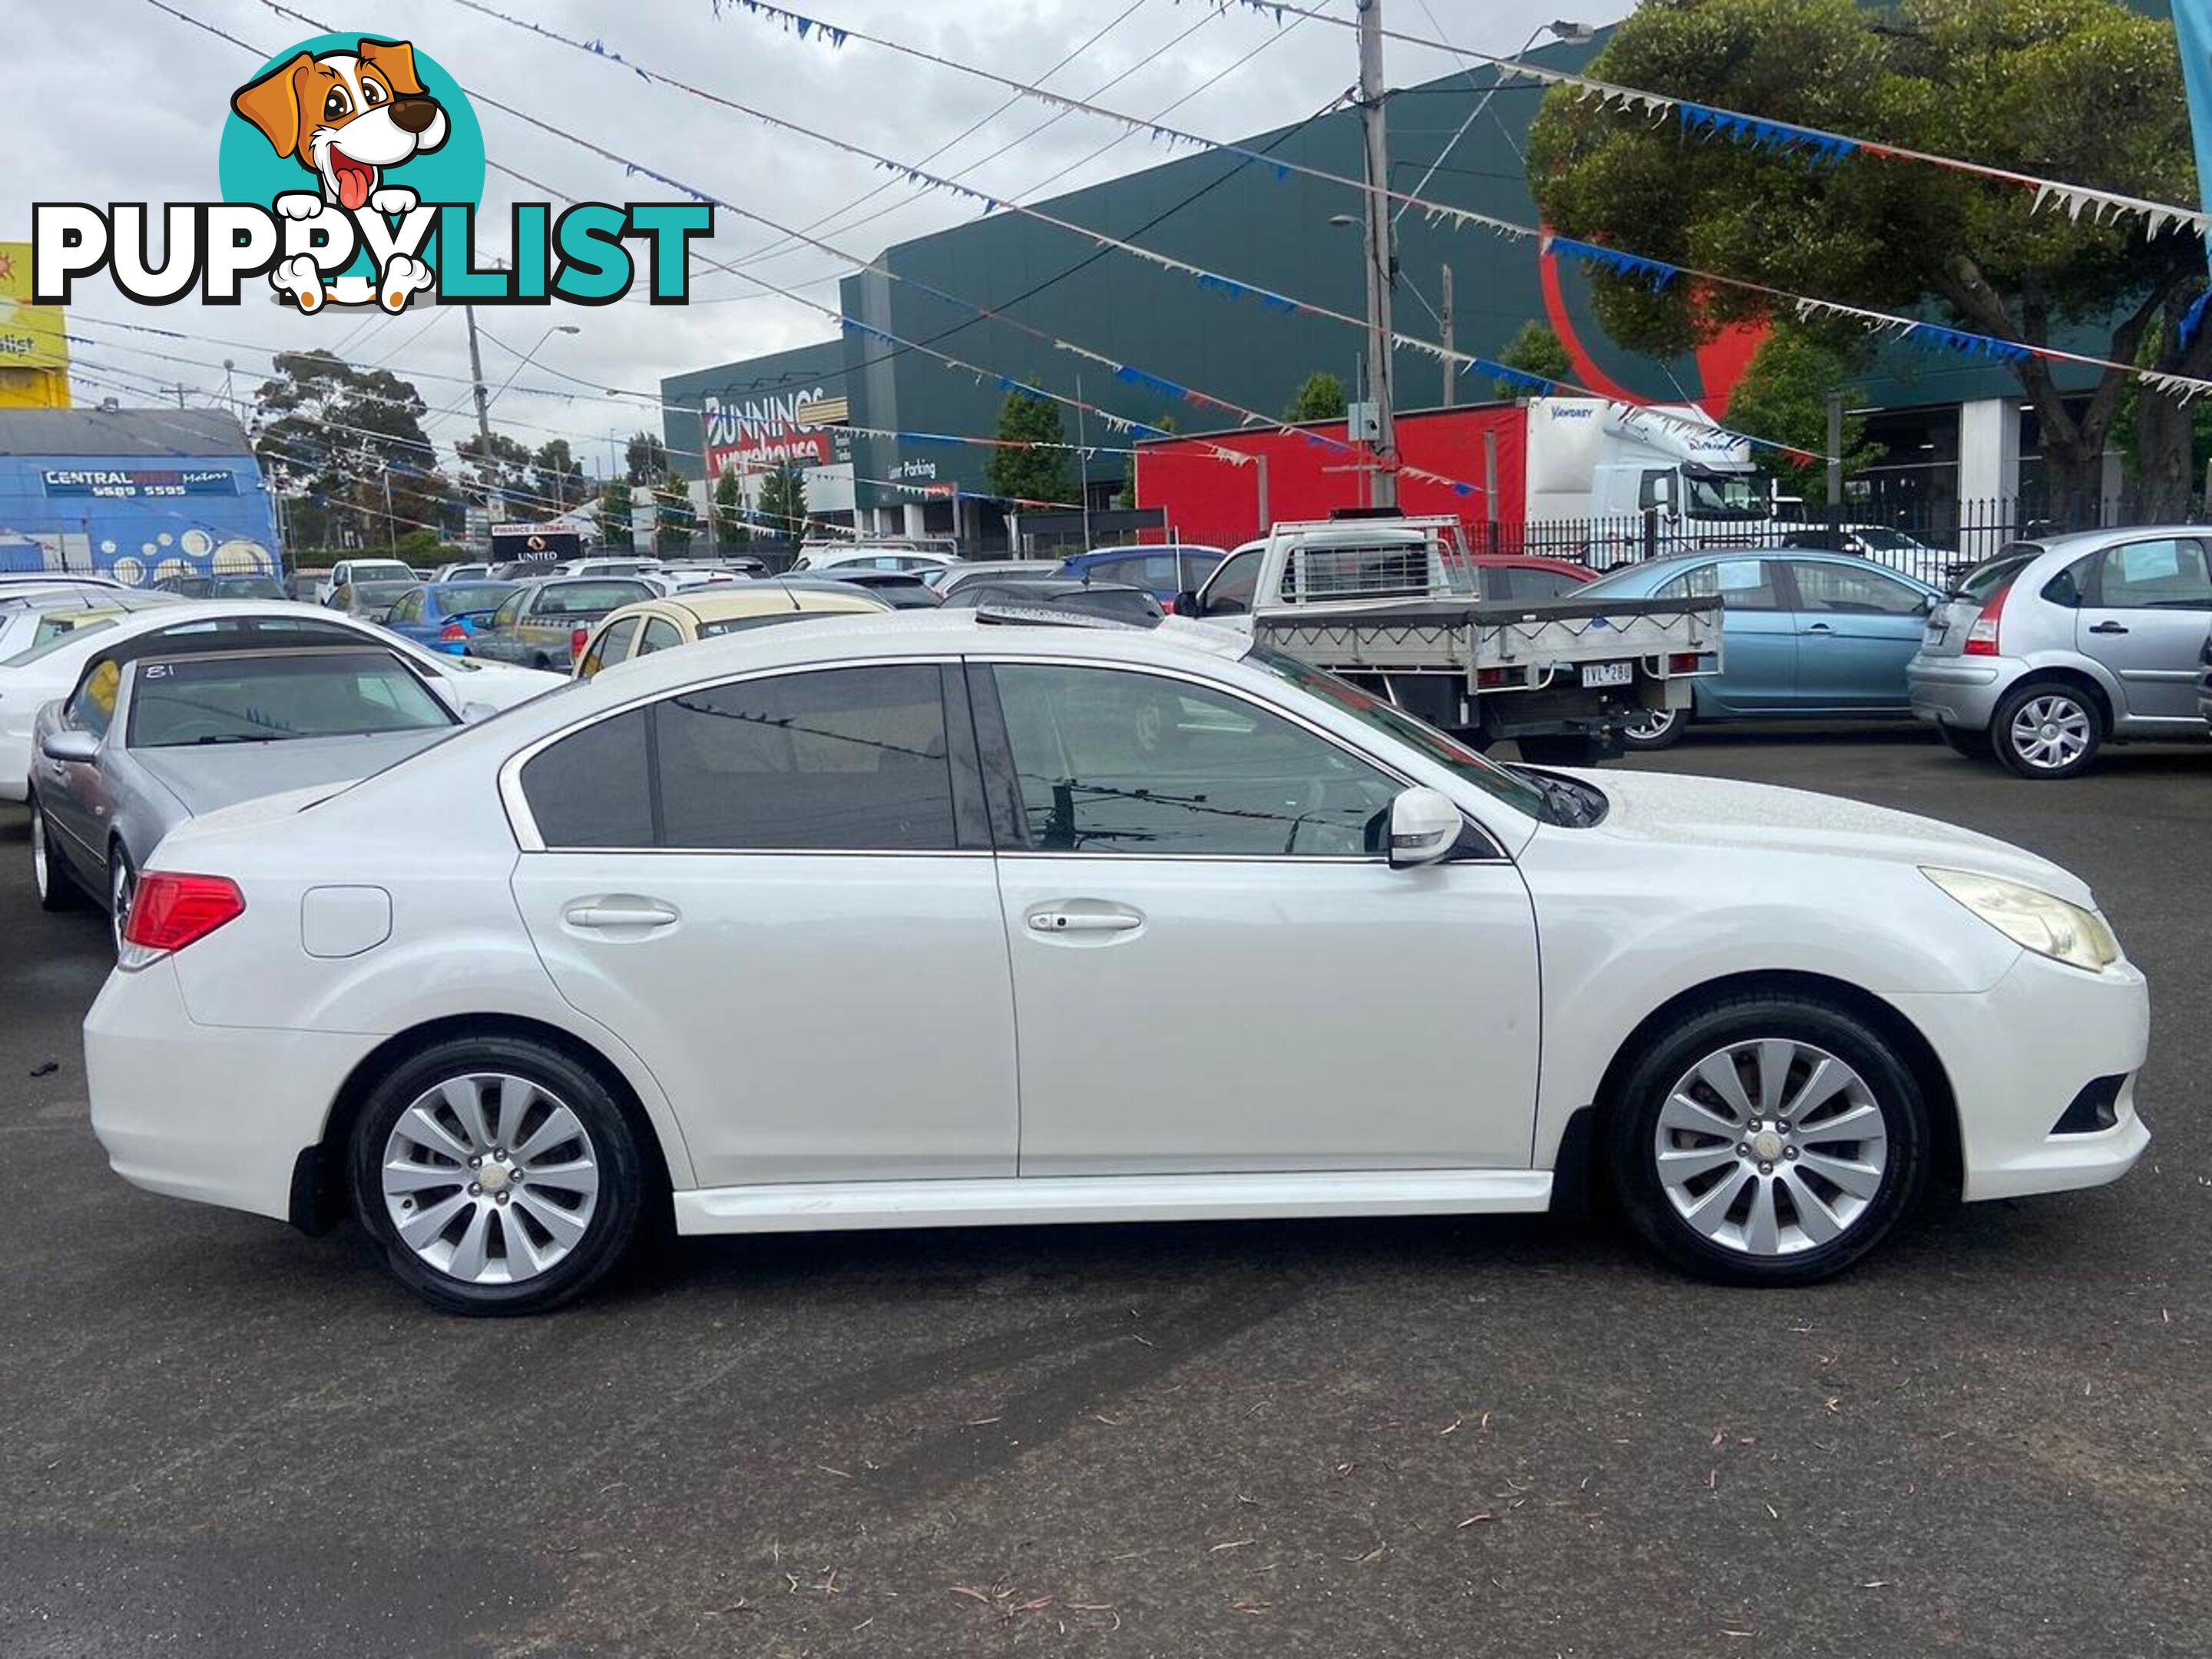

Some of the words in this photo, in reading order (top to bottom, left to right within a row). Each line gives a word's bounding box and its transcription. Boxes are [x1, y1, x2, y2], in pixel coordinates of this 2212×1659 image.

[904, 458, 935, 479] Parking
[45, 471, 134, 485] CENTRAL
[182, 472, 229, 485] Motors
[518, 551, 558, 561] UNITED
